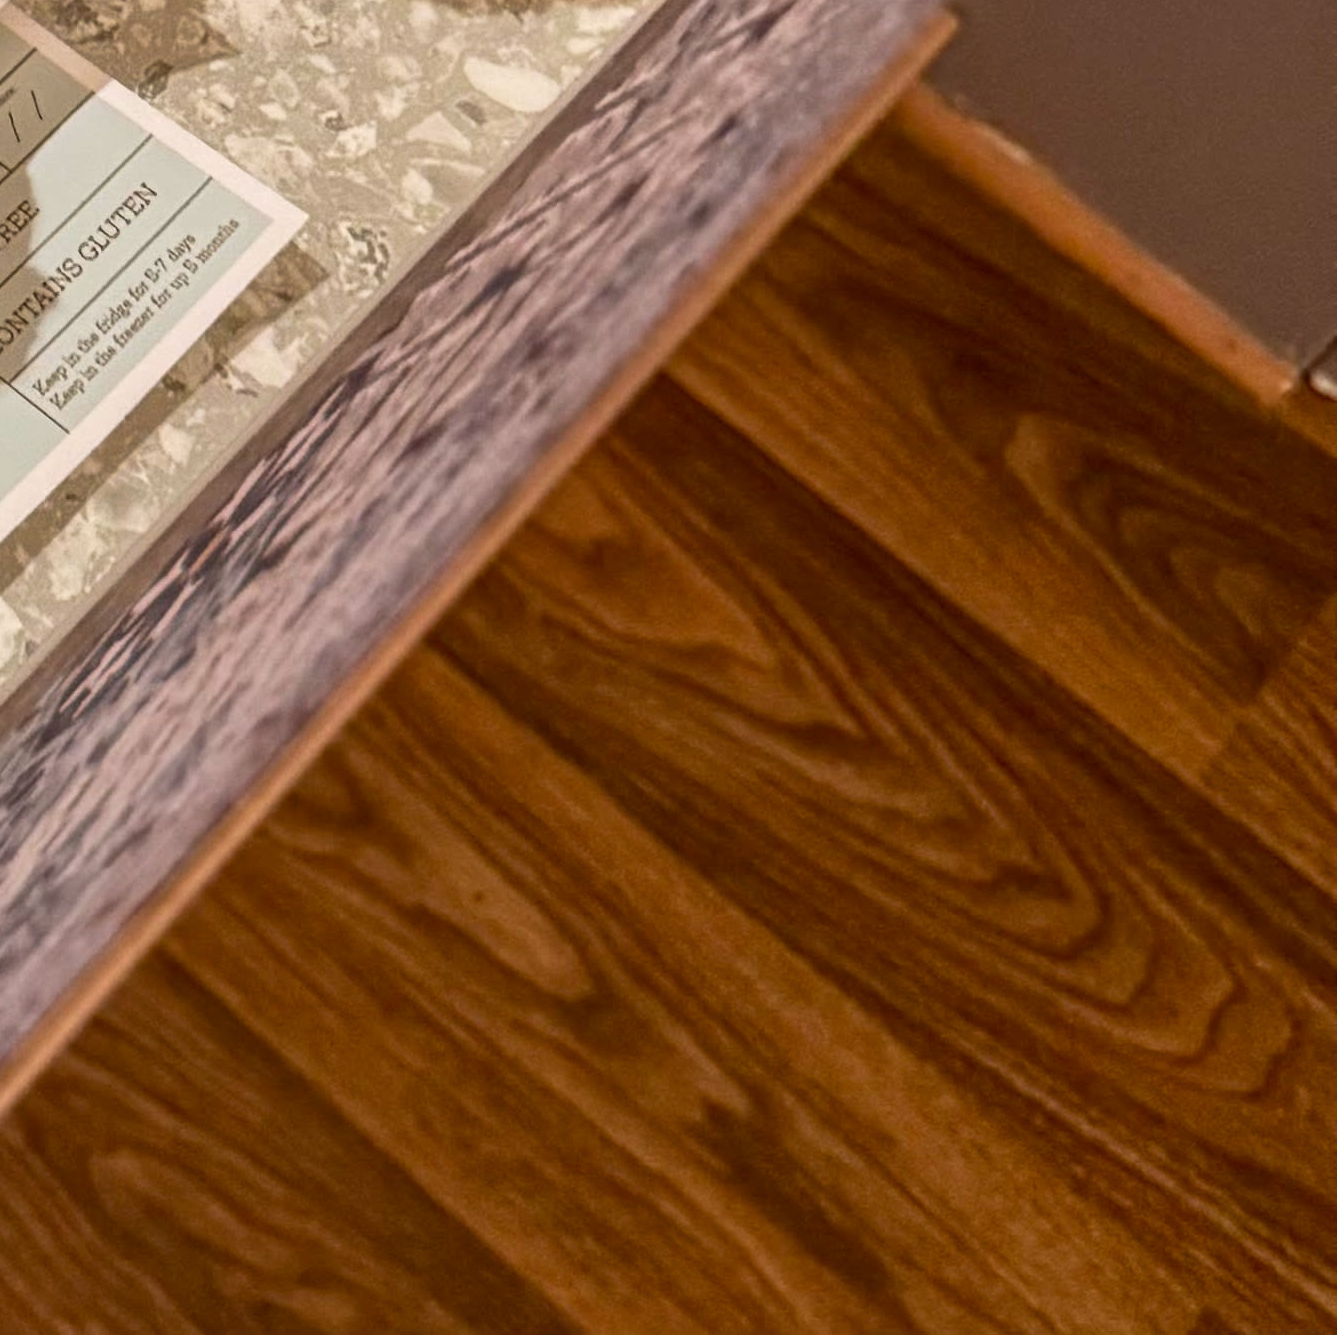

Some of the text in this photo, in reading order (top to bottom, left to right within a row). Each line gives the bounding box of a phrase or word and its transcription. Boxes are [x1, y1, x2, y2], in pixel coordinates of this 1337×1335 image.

[77, 181, 158, 263] GLUTEN
[32, 364, 68, 397] Keep
[63, 350, 81, 370] in
[76, 332, 100, 354] the
[94, 299, 133, 335] fridge
[128, 281, 151, 302] for
[167, 233, 197, 262] days
[49, 380, 87, 411] Keep
[79, 365, 99, 382] in
[95, 346, 117, 368] the
[112, 307, 156, 349] freezer
[150, 287, 173, 310] for
[169, 271, 191, 291] up
[194, 217, 241, 265] months
